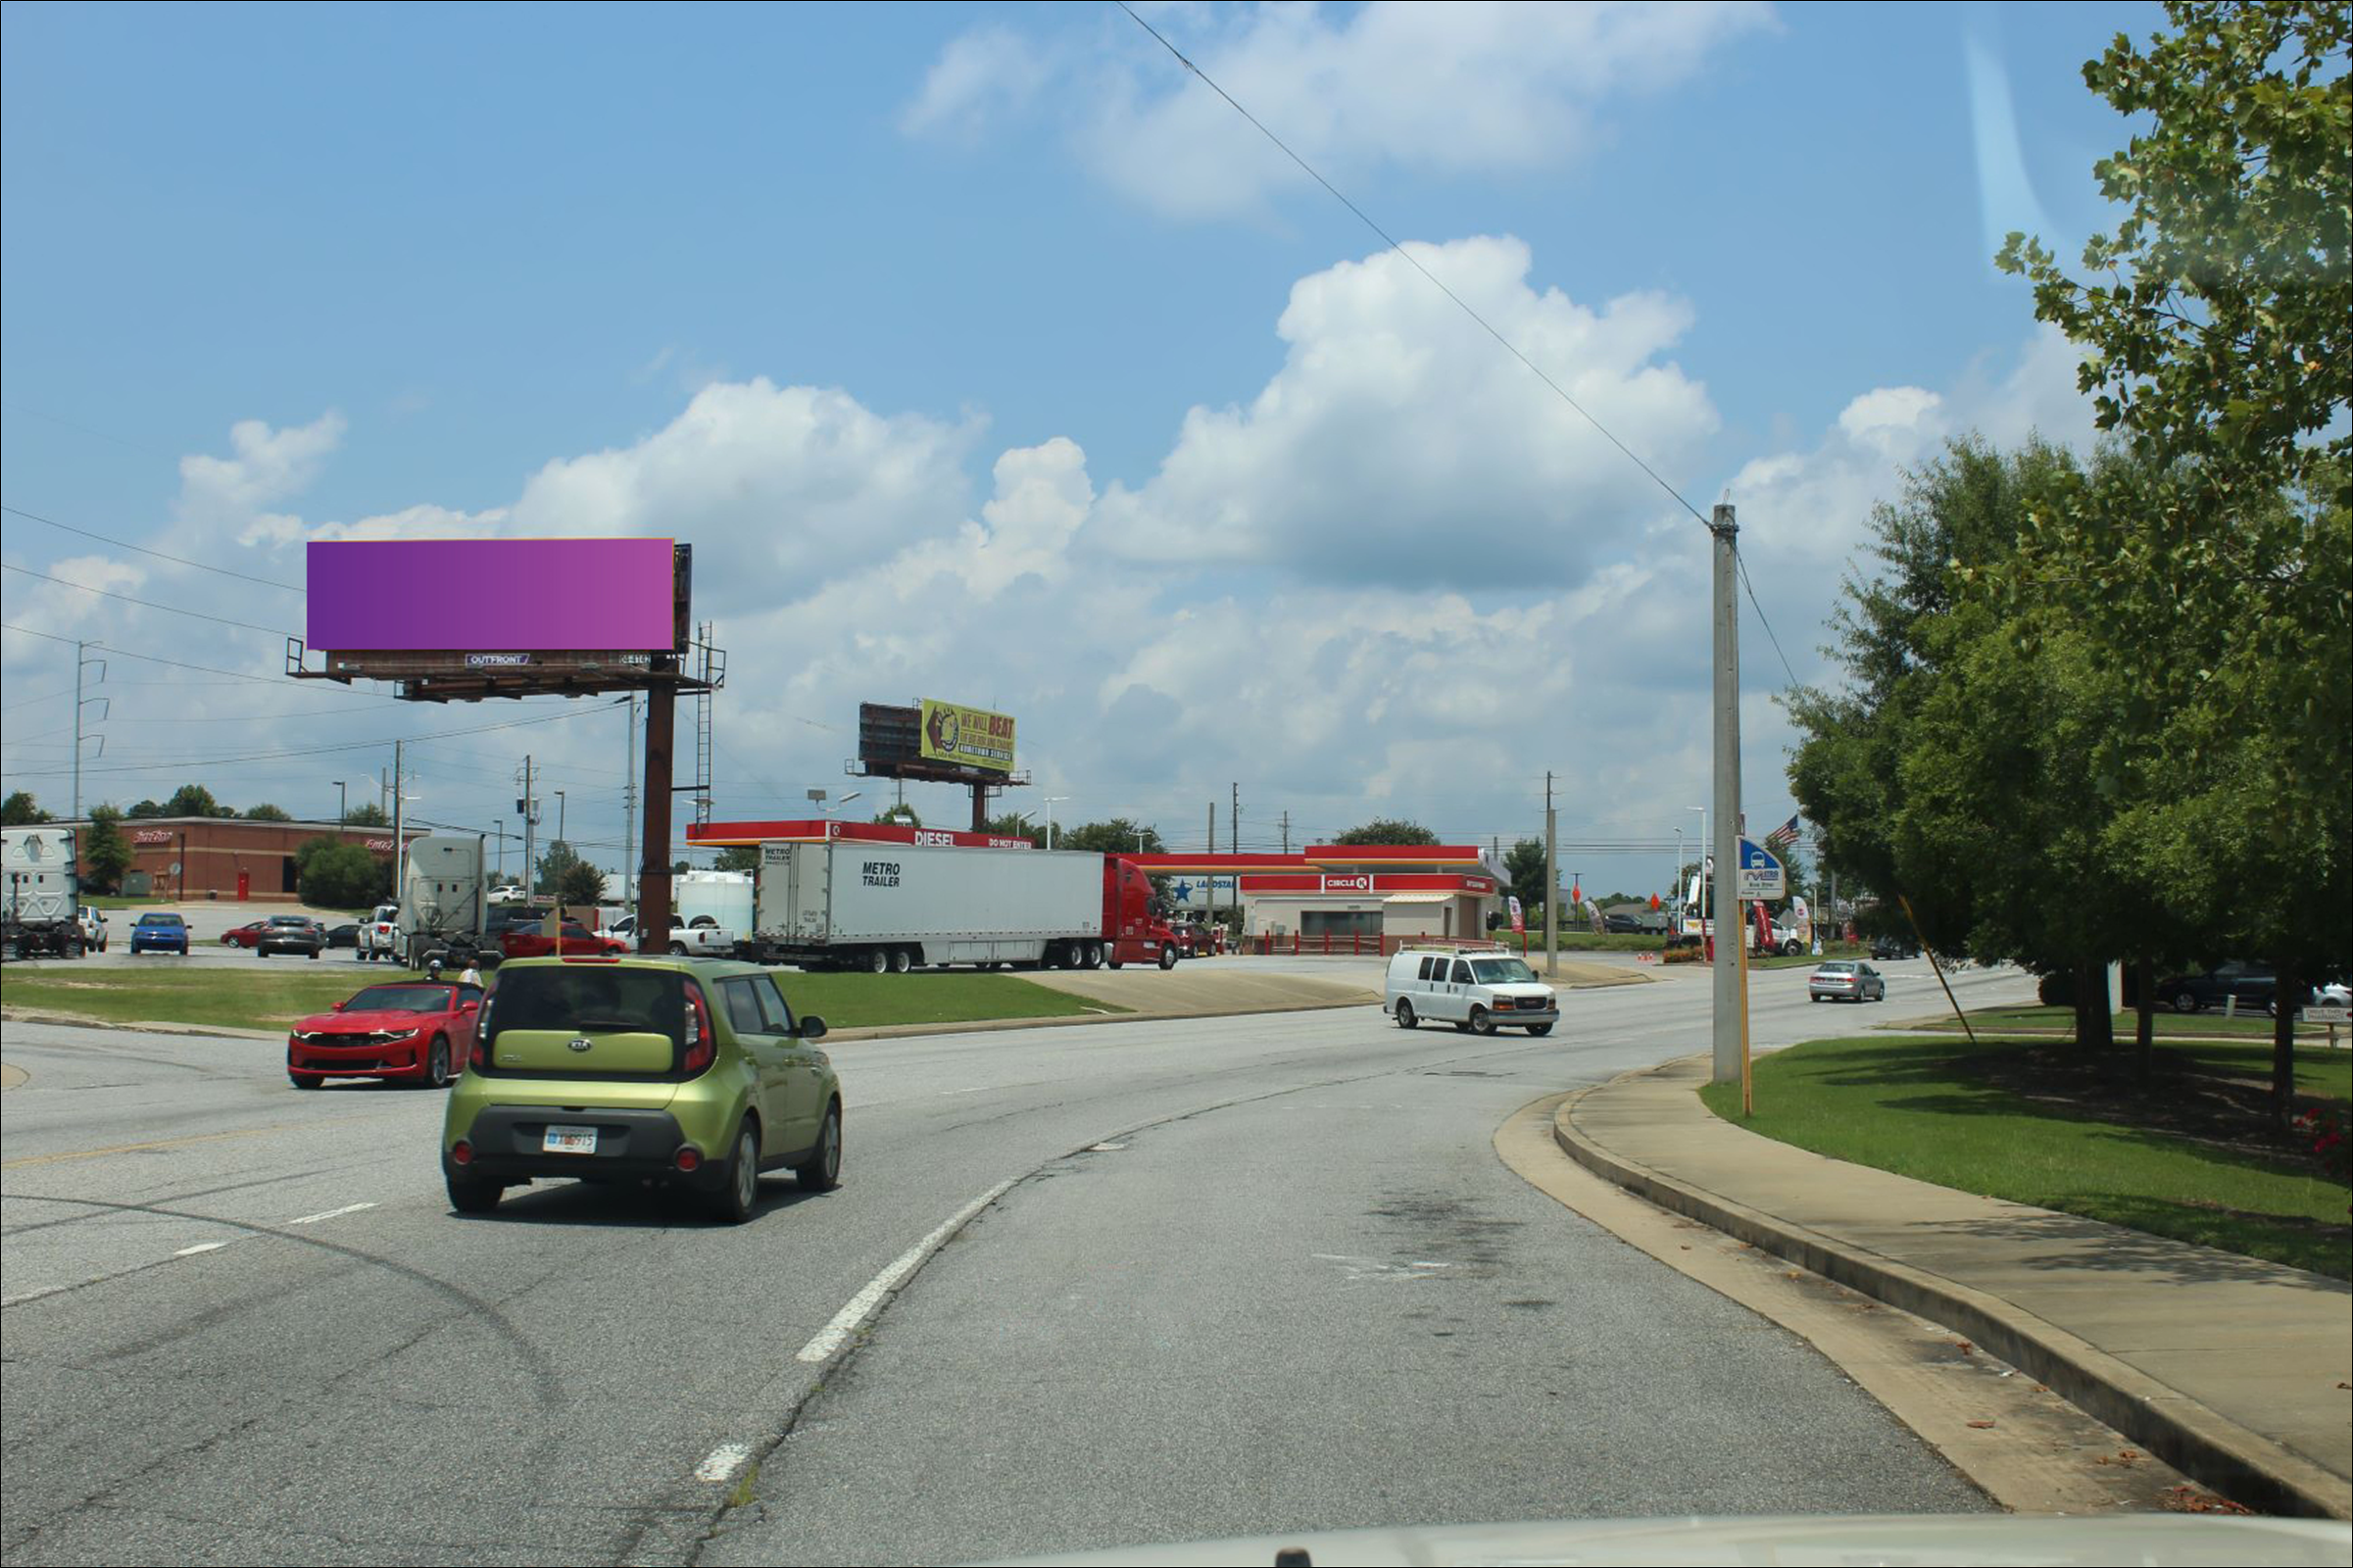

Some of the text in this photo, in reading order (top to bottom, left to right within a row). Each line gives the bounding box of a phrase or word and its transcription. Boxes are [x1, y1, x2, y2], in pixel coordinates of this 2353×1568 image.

[915, 831, 954, 847] DIESEL
[989, 838, 1032, 850] DO NOT ENTER
[862, 861, 900, 875] METRO
[862, 875, 900, 887] TRAILER
